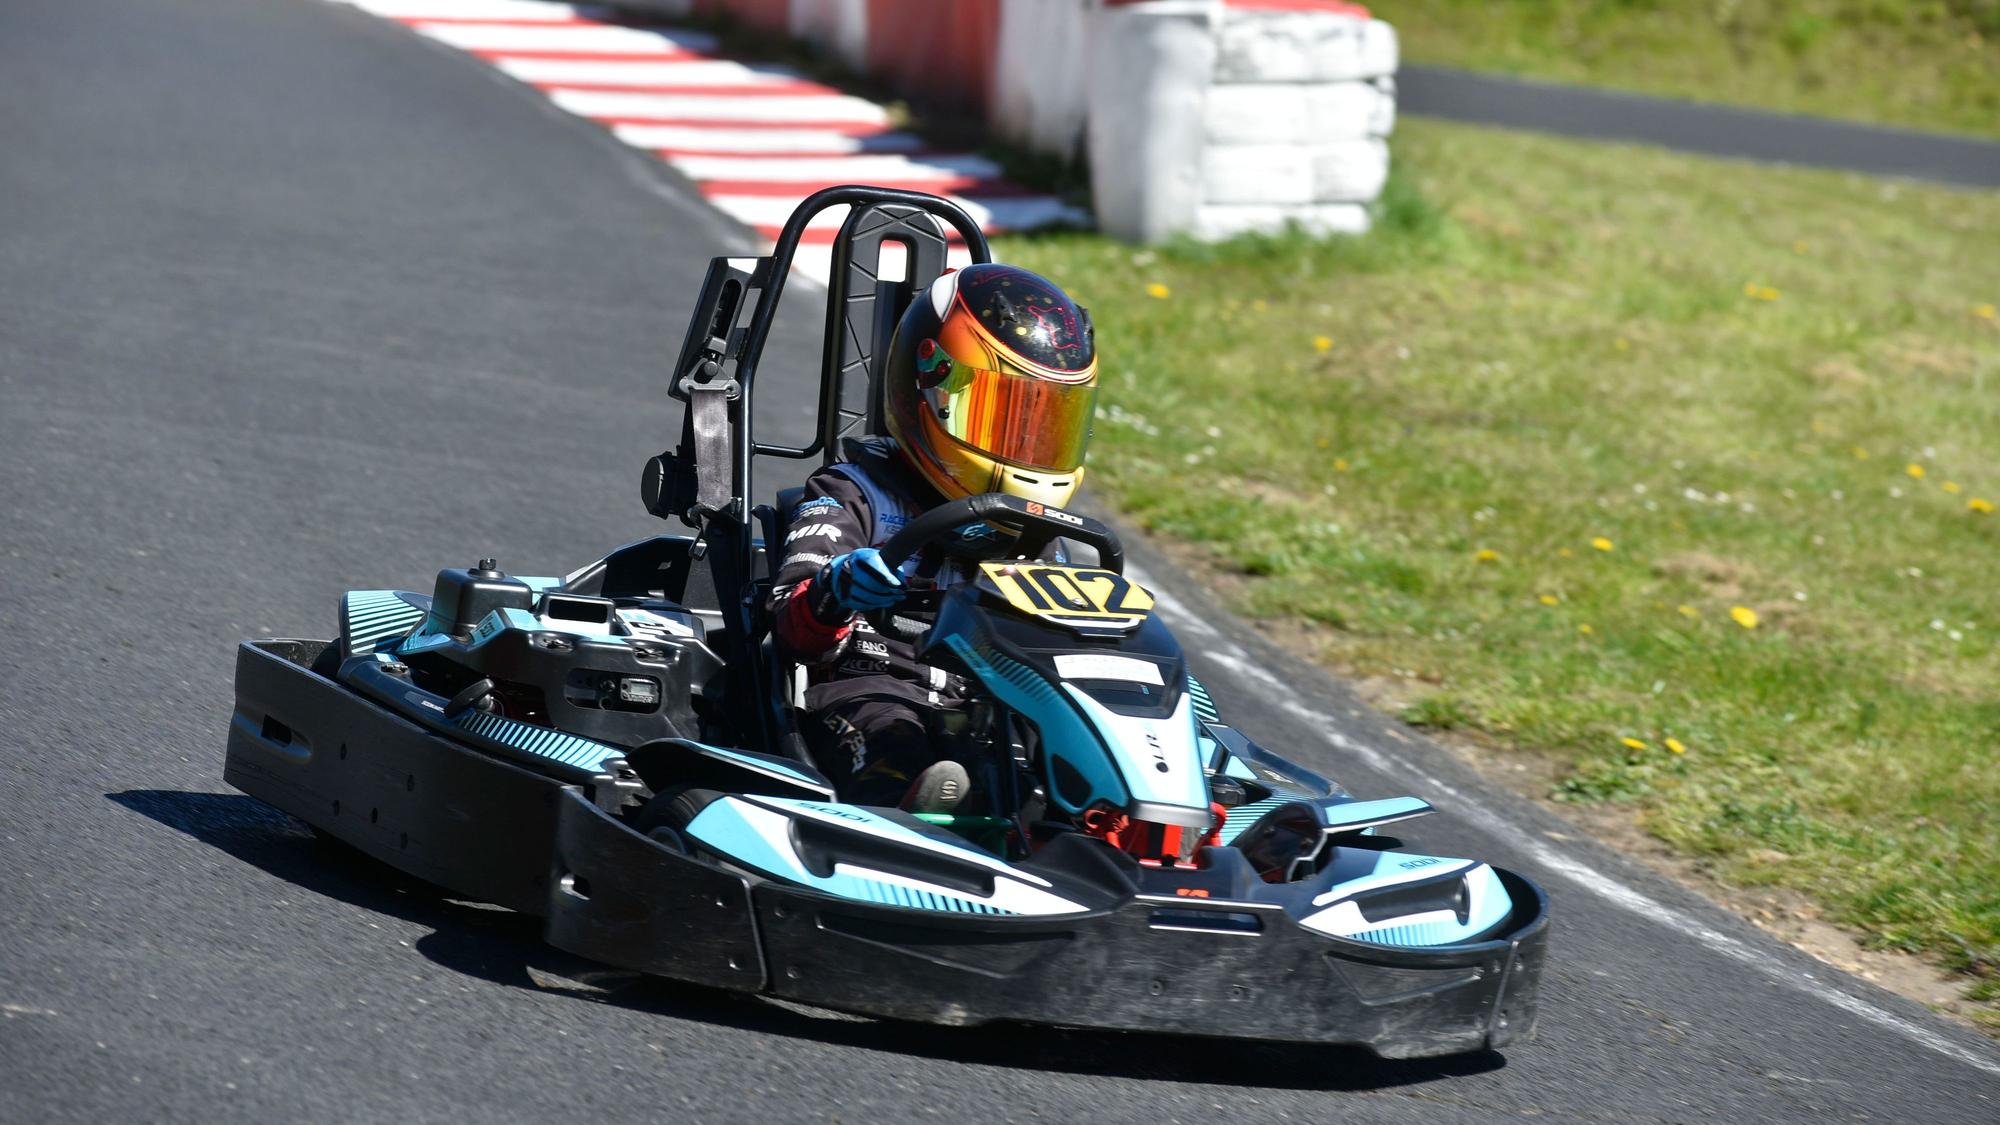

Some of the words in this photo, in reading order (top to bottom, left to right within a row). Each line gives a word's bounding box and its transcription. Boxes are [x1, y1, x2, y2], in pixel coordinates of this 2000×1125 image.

[1044, 508, 1083, 526] SODI
[784, 523, 842, 546] MIR
[993, 568, 1153, 614] 102
[799, 802, 872, 824] SODI
[1398, 857, 1441, 870] SODI
